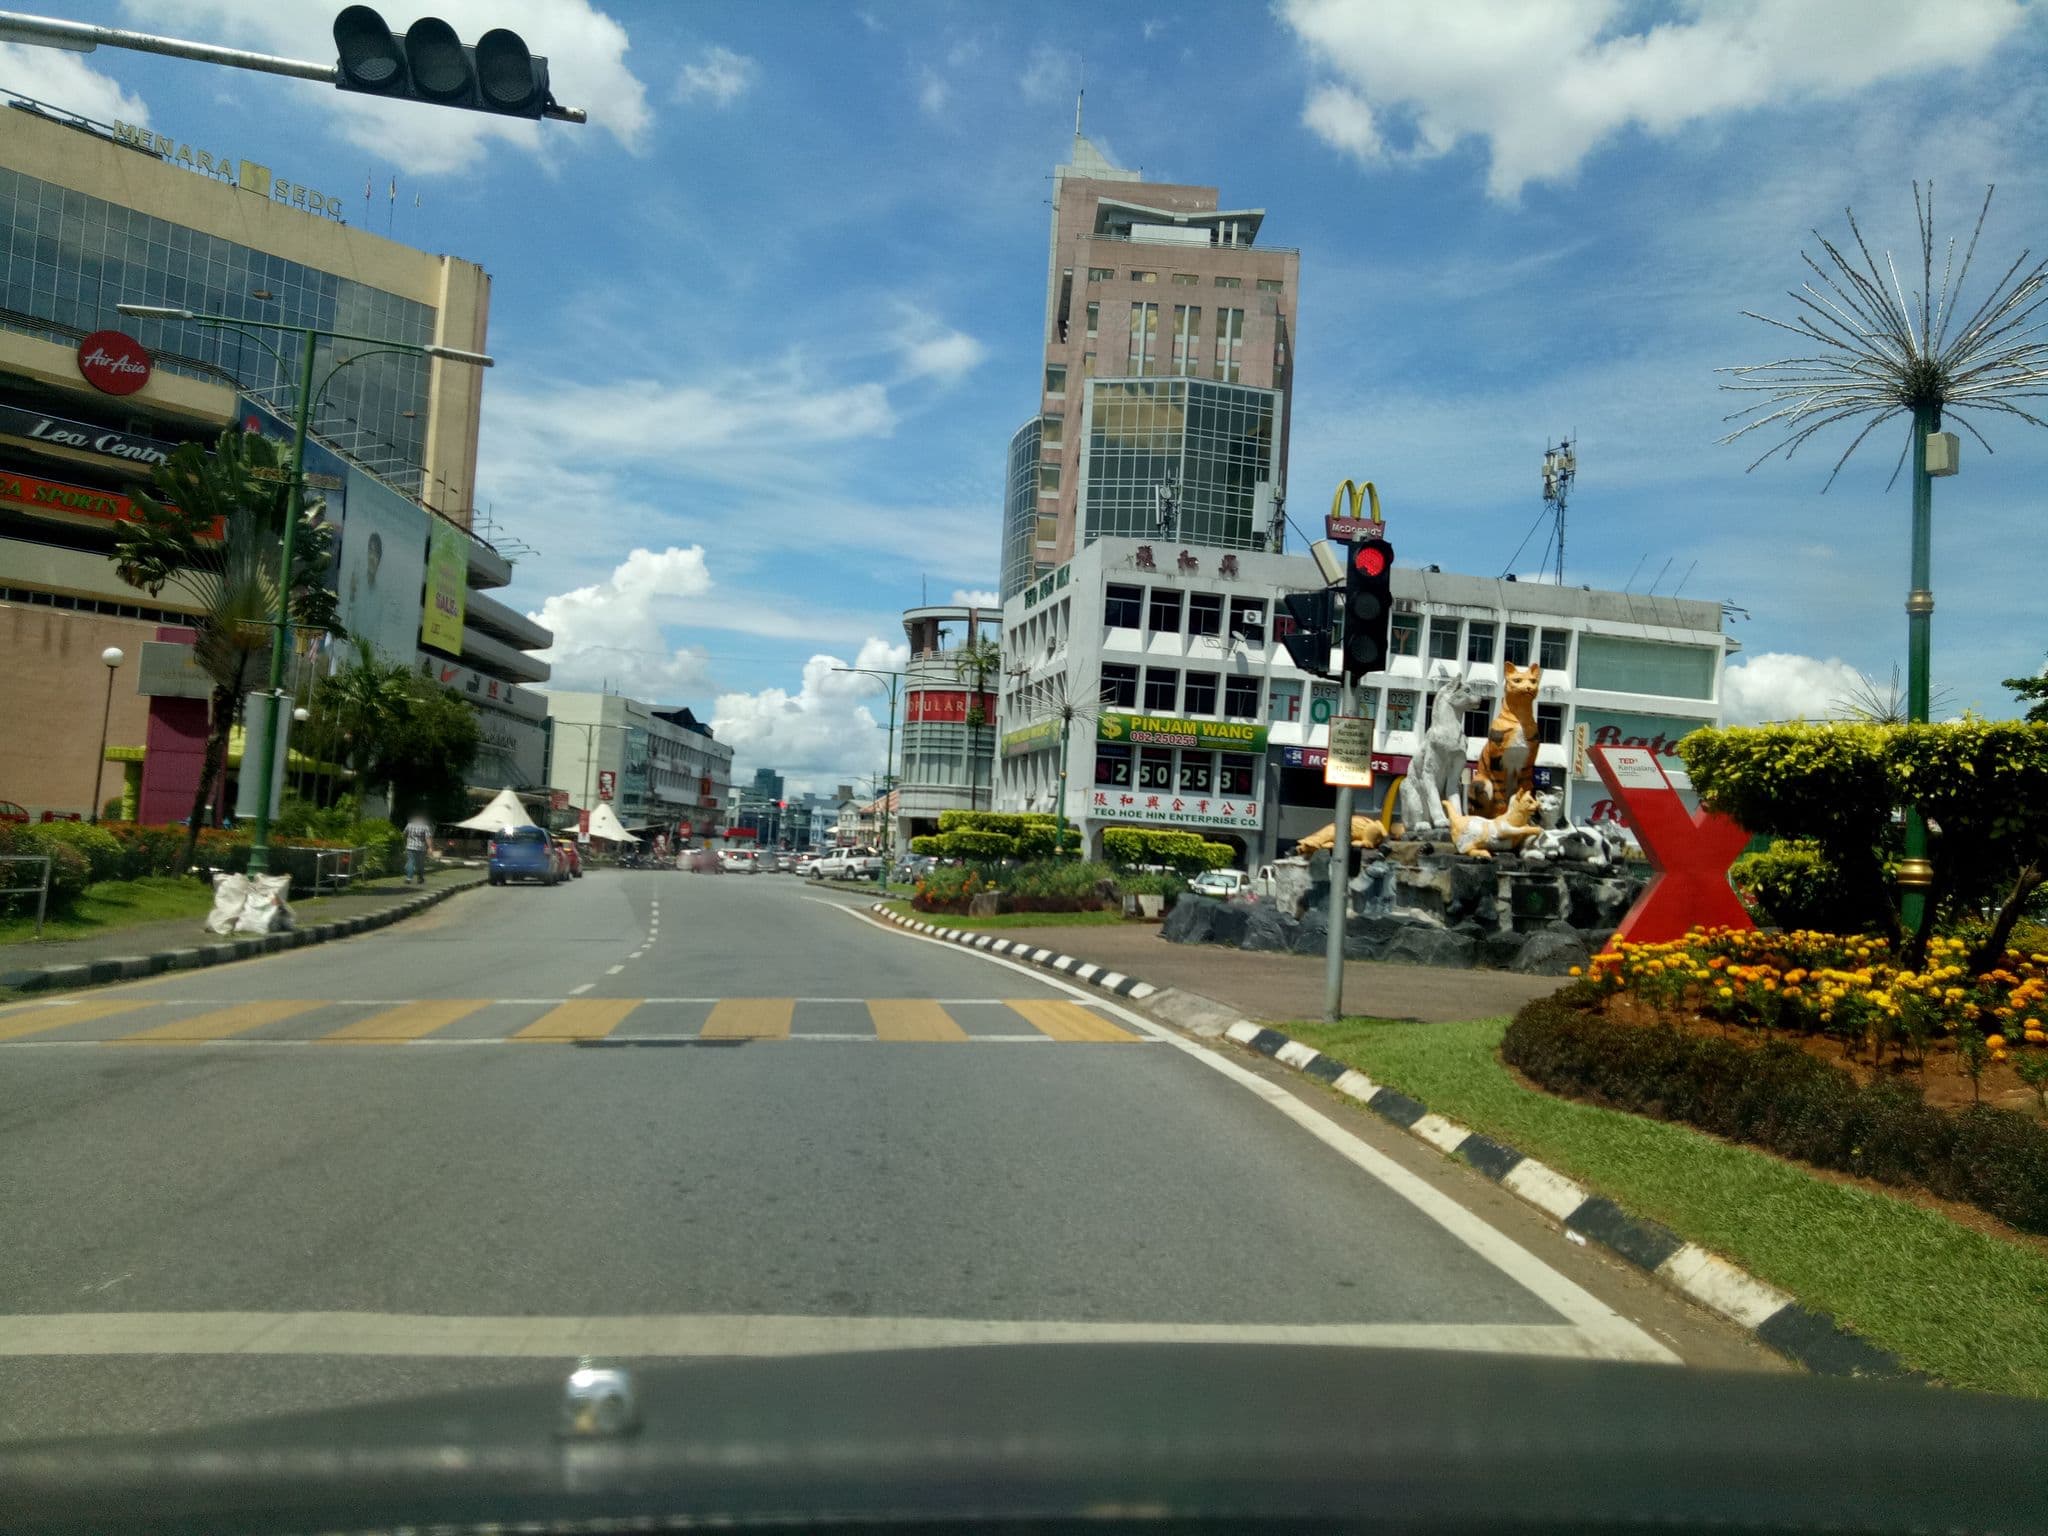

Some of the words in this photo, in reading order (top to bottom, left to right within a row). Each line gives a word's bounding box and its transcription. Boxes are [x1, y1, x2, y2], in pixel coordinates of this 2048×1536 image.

[113, 118, 233, 179] MENARA
[275, 178, 344, 217] SEDC
[27, 420, 90, 446] Lea
[95, 434, 173, 465] Centr
[34, 484, 117, 515] SPORTS
[1130, 717, 1197, 735] PINJAM
[1202, 722, 1254, 740] WANG
[1130, 731, 1197, 746] 082-250253
[1094, 808, 1116, 817] TEO
[1119, 809, 1142, 818] HOE
[1146, 811, 1166, 820] HIN
[1169, 813, 1237, 825] ENTERPRISE
